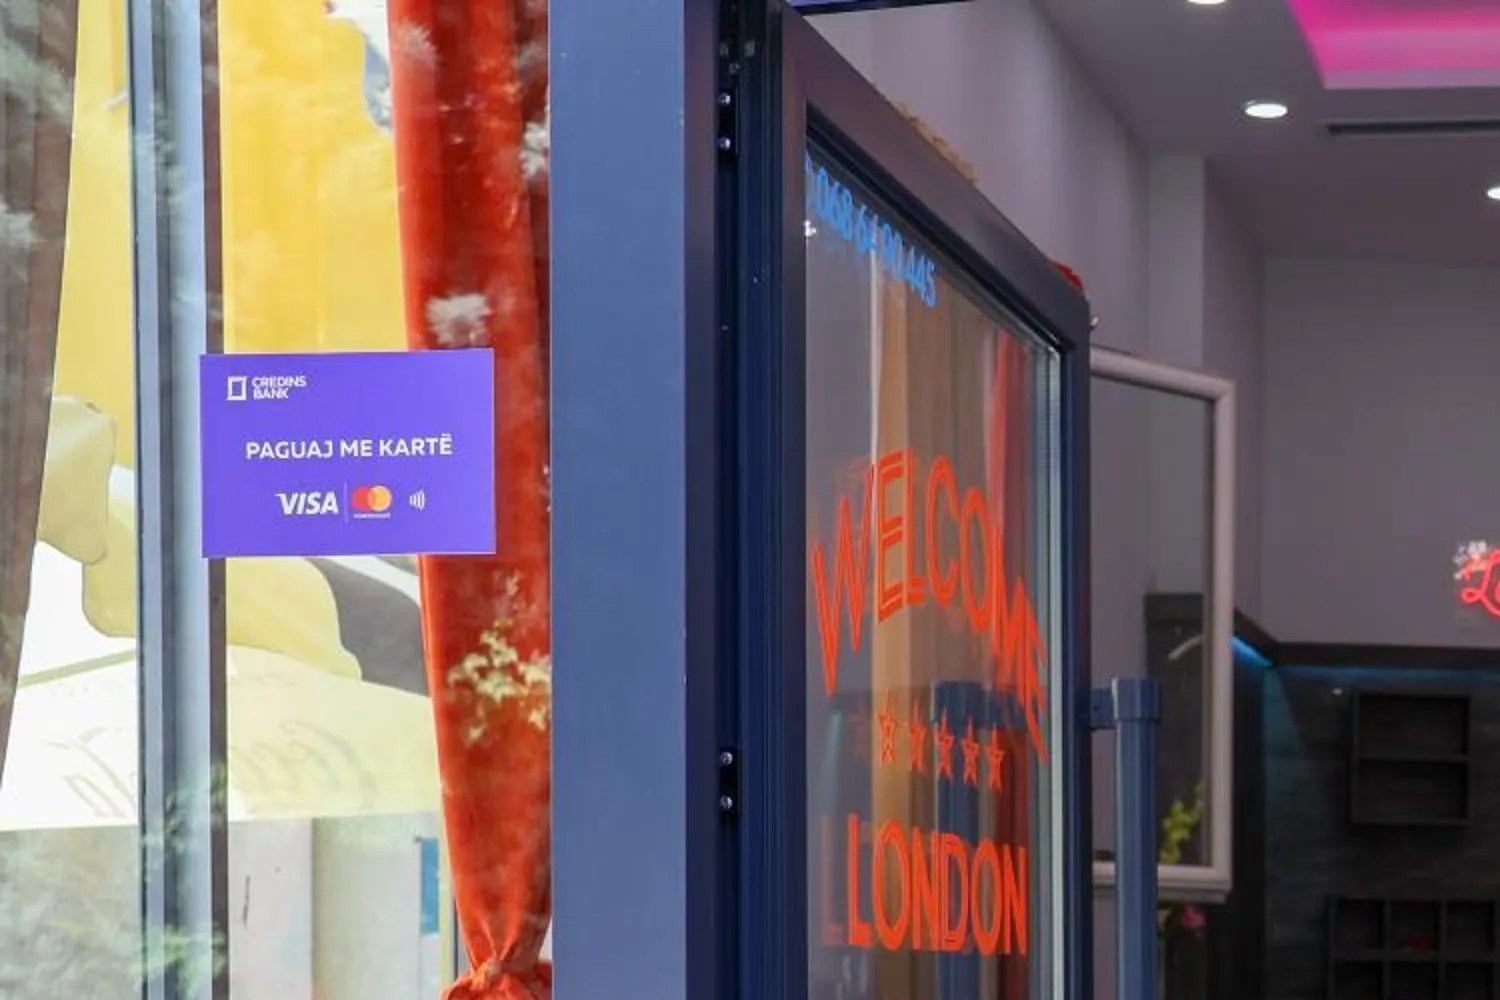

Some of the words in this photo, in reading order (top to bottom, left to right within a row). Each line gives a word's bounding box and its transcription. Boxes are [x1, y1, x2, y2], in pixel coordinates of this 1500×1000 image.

[251, 375, 308, 388] CREDINS
[252, 387, 289, 400] BANK
[246, 440, 333, 461] PAGUAJ
[340, 438, 373, 457] ME
[379, 433, 454, 456] KARTË
[275, 491, 340, 515] VISA
[846, 812, 1028, 957] LONDON
